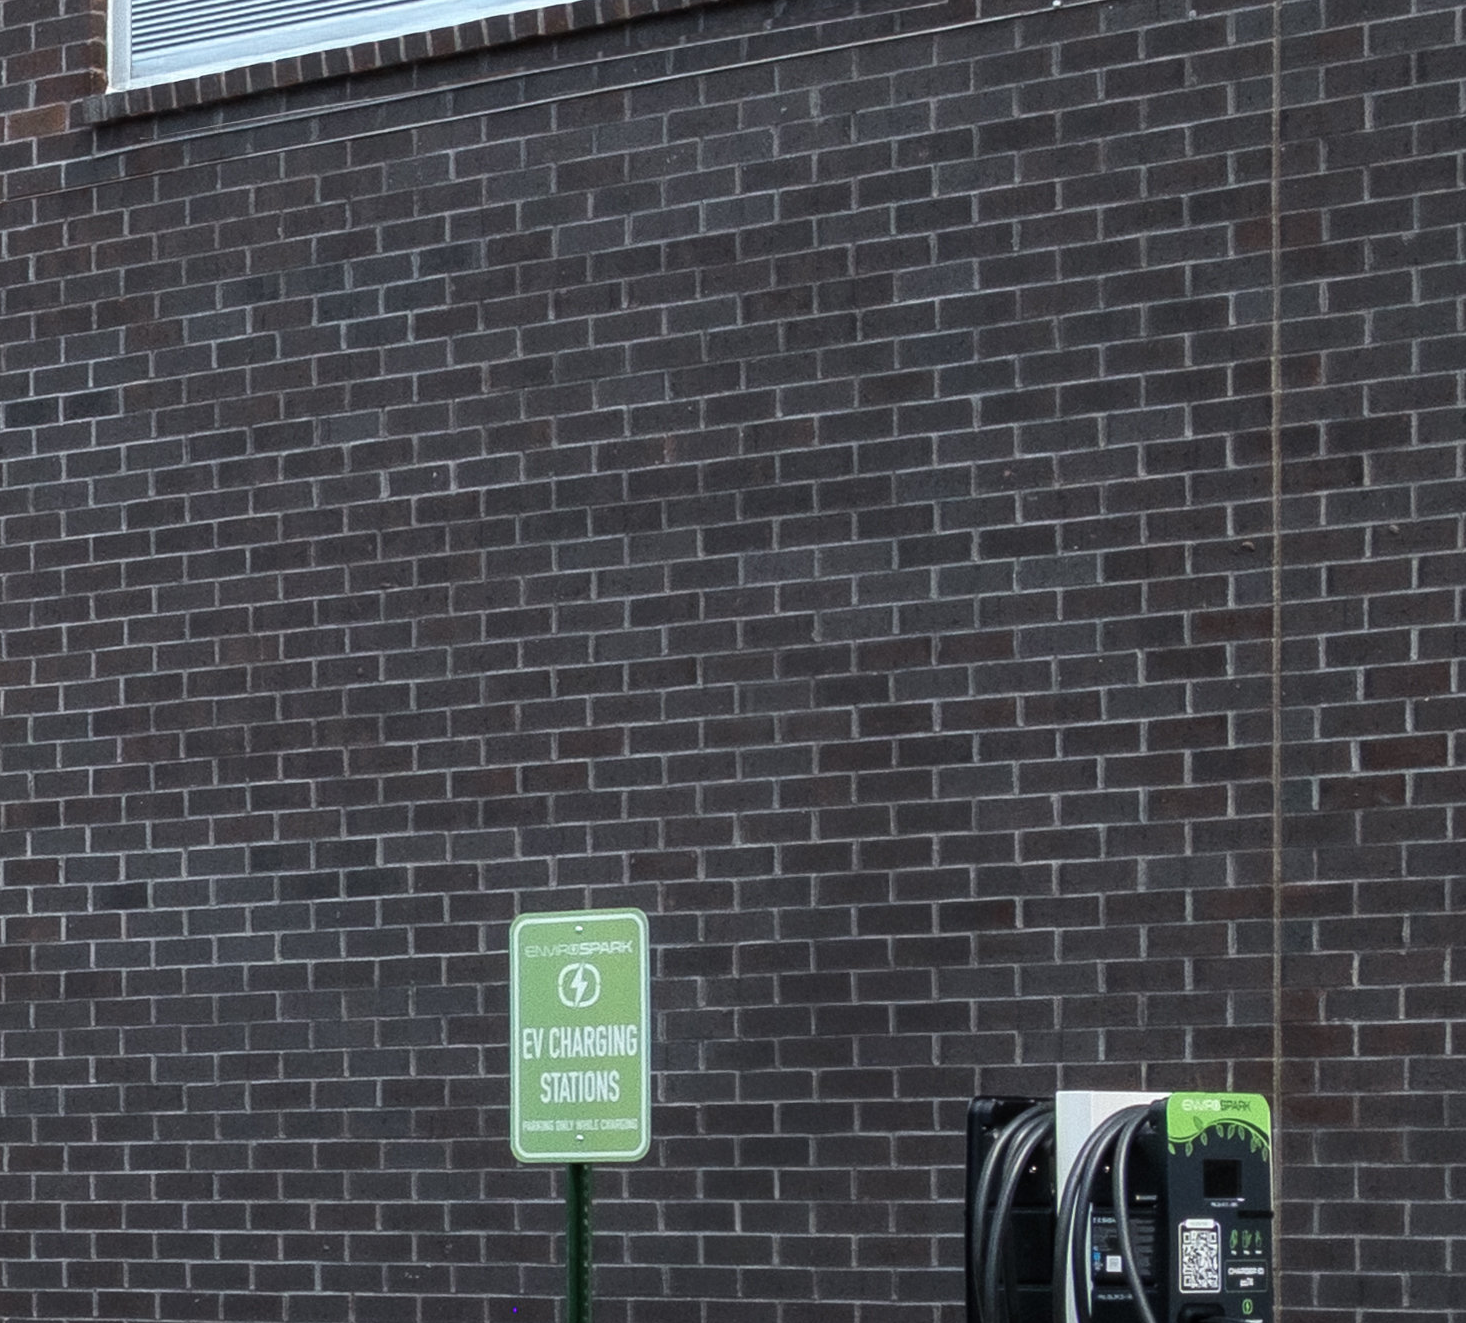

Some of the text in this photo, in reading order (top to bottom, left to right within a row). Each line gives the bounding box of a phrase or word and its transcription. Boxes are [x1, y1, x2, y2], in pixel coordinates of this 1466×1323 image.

[523, 1024, 638, 1059] EV CHARGING
[540, 1069, 620, 1103] STATIONS
